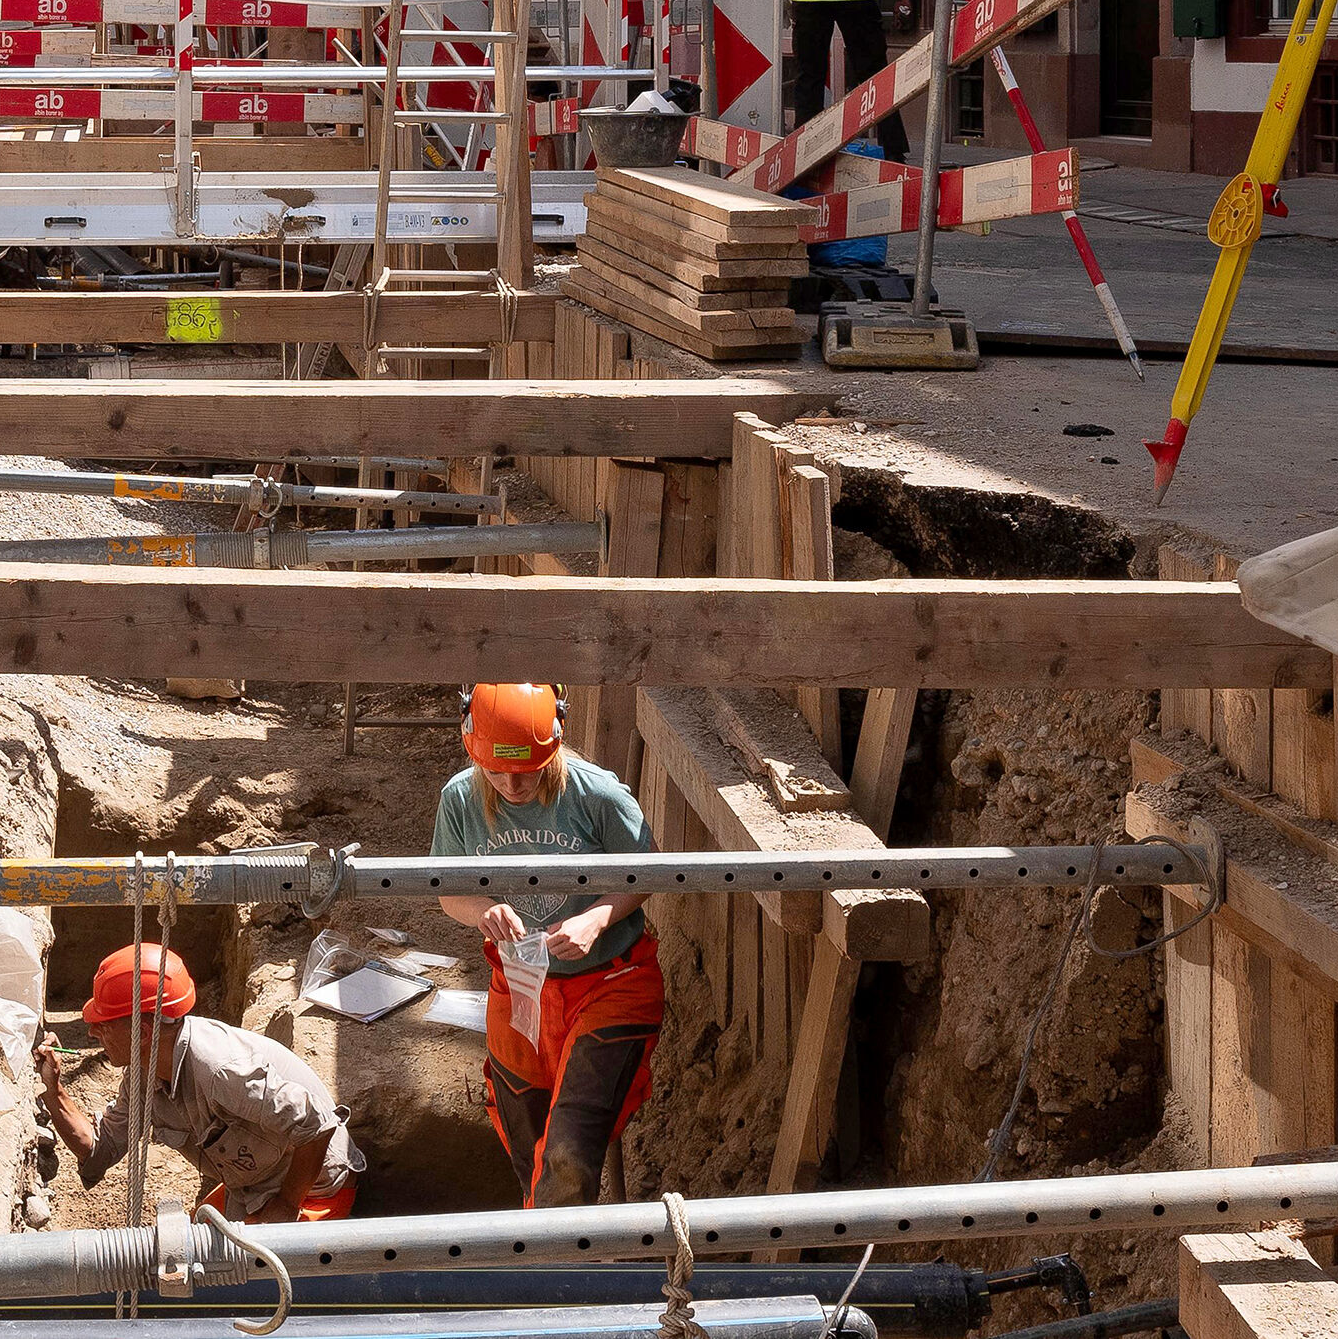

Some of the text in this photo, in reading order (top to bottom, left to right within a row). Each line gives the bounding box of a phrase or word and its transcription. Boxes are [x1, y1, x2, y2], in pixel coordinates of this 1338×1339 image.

[242, 0, 272, 18] ab
[156, 46, 171, 56] ab
[35, 90, 64, 110] ab
[238, 94, 269, 114] ab
[861, 80, 876, 116] ab
[737, 130, 749, 158] ab
[768, 154, 782, 186] ab
[475, 829, 583, 857] CAMBRIDGE
